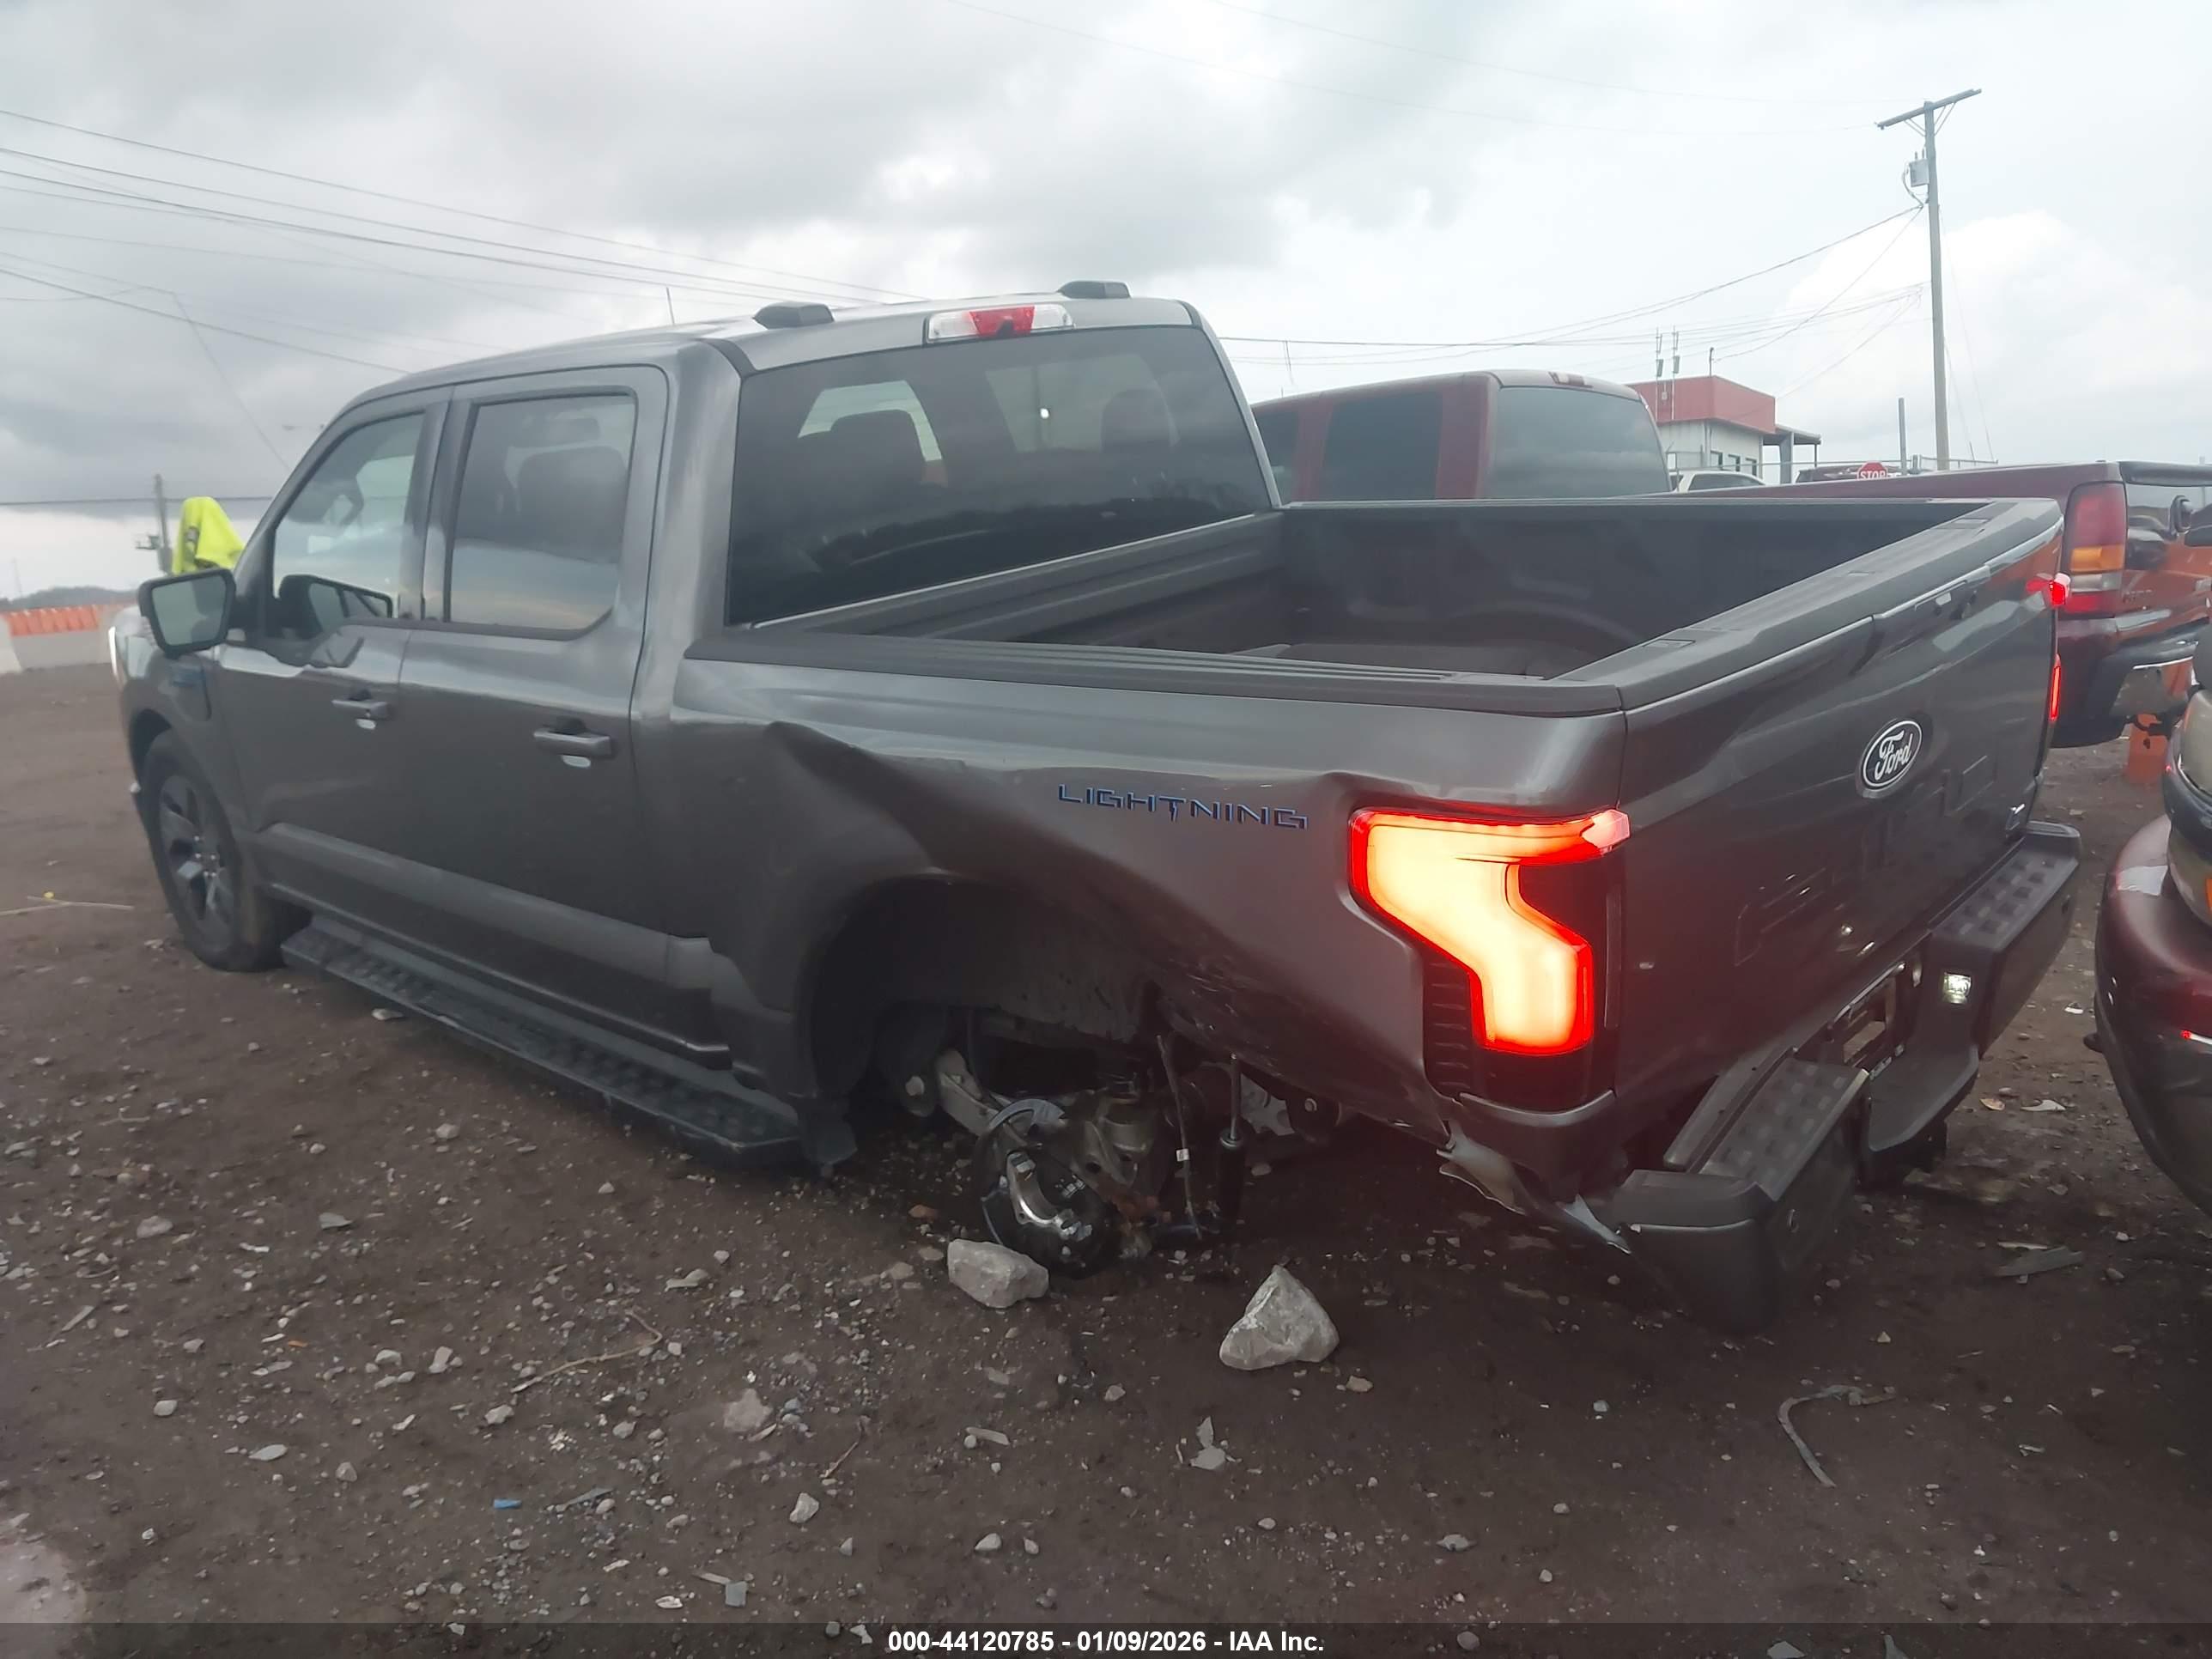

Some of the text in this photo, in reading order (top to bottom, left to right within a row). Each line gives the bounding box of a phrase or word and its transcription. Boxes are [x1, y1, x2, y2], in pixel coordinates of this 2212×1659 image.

[1860, 470, 1886, 480] STOP
[1875, 730, 1913, 781] Ford
[1058, 783, 1309, 830] LIGHTNING
